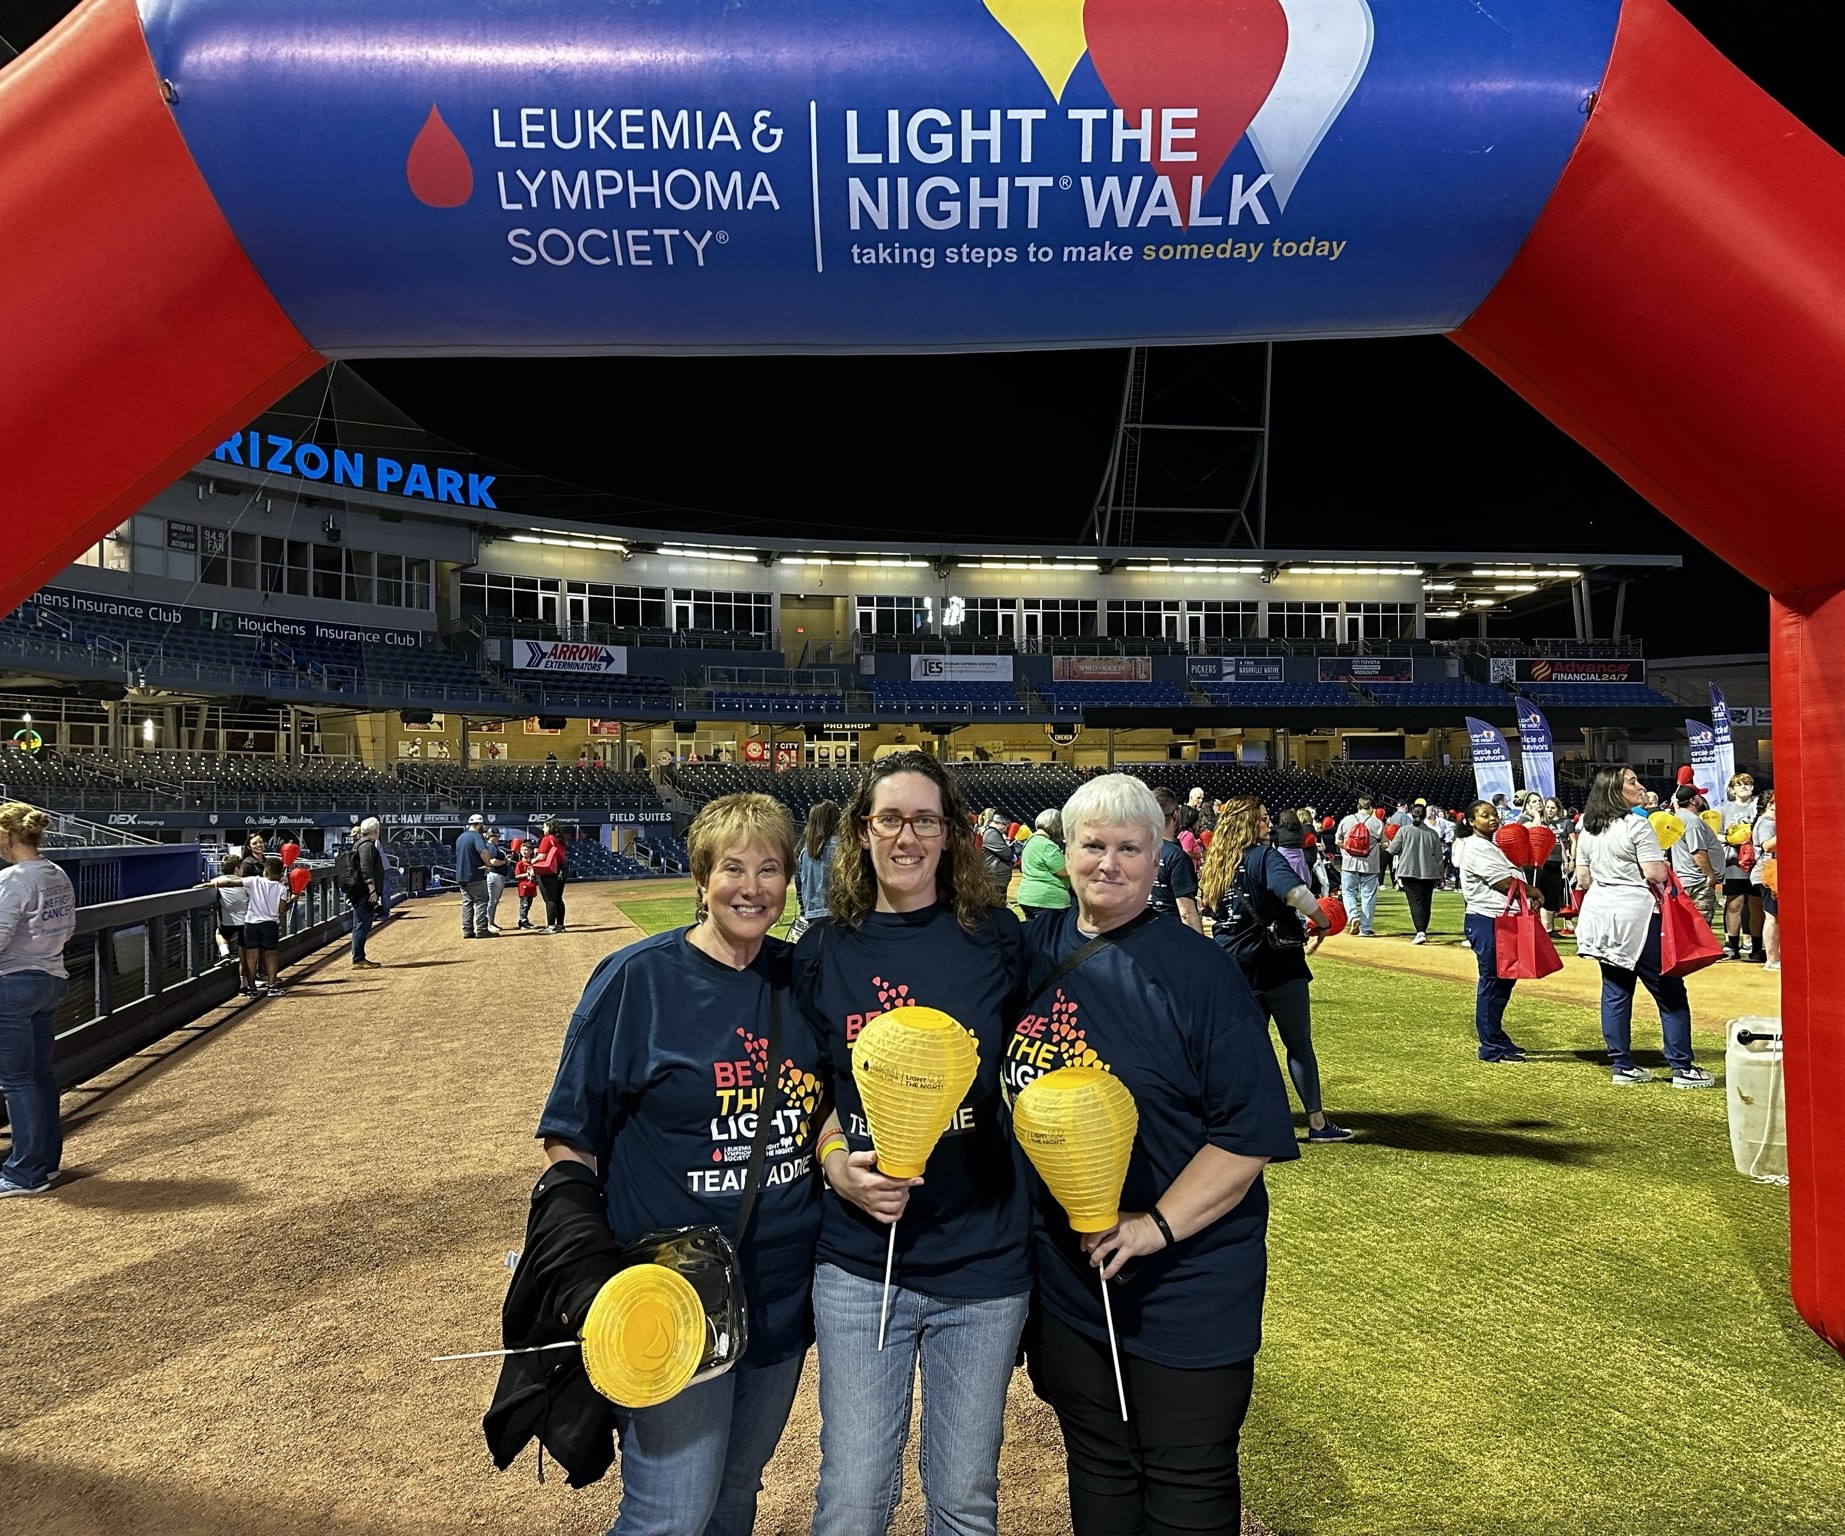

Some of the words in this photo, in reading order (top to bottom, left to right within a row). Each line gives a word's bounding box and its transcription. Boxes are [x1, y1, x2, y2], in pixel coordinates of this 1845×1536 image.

[492, 108, 741, 150] LEUKEMIA
[752, 111, 784, 153] &
[846, 108, 1046, 164] LIGHT
[1068, 108, 1198, 162] THE
[498, 169, 780, 210] LYMPHOMA
[1081, 173, 1276, 229] WALK
[851, 243, 935, 268] taking
[945, 245, 1017, 268] steps
[1028, 245, 1053, 262] to
[1063, 241, 1134, 262] make
[1142, 238, 1264, 266] someday
[1271, 237, 1346, 262] today
[215, 431, 363, 488] RIZON
[378, 458, 497, 509] PARK
[72, 596, 143, 618] Insurance
[149, 607, 182, 624] Club
[238, 617, 306, 636] Houchens
[316, 625, 380, 642] Insurance
[385, 632, 414, 646] Club
[544, 660, 602, 671] EXTERMINATORS
[548, 644, 604, 662] ARROW
[922, 659, 943, 676] IES
[1191, 665, 1216, 674] PICKERS
[1553, 661, 1628, 673] Advance
[108, 814, 138, 824] DEX
[529, 814, 555, 822] DEX
[610, 813, 634, 822] FIELD
[639, 813, 672, 822] SUITES
[403, 831, 425, 840] Drnk
[1016, 1015, 1048, 1038] BE
[1007, 1034, 1059, 1069] THE
[714, 1061, 752, 1088] BE
[775, 1147, 795, 1156] NIGHT
[766, 1155, 812, 1187] ADDIE
